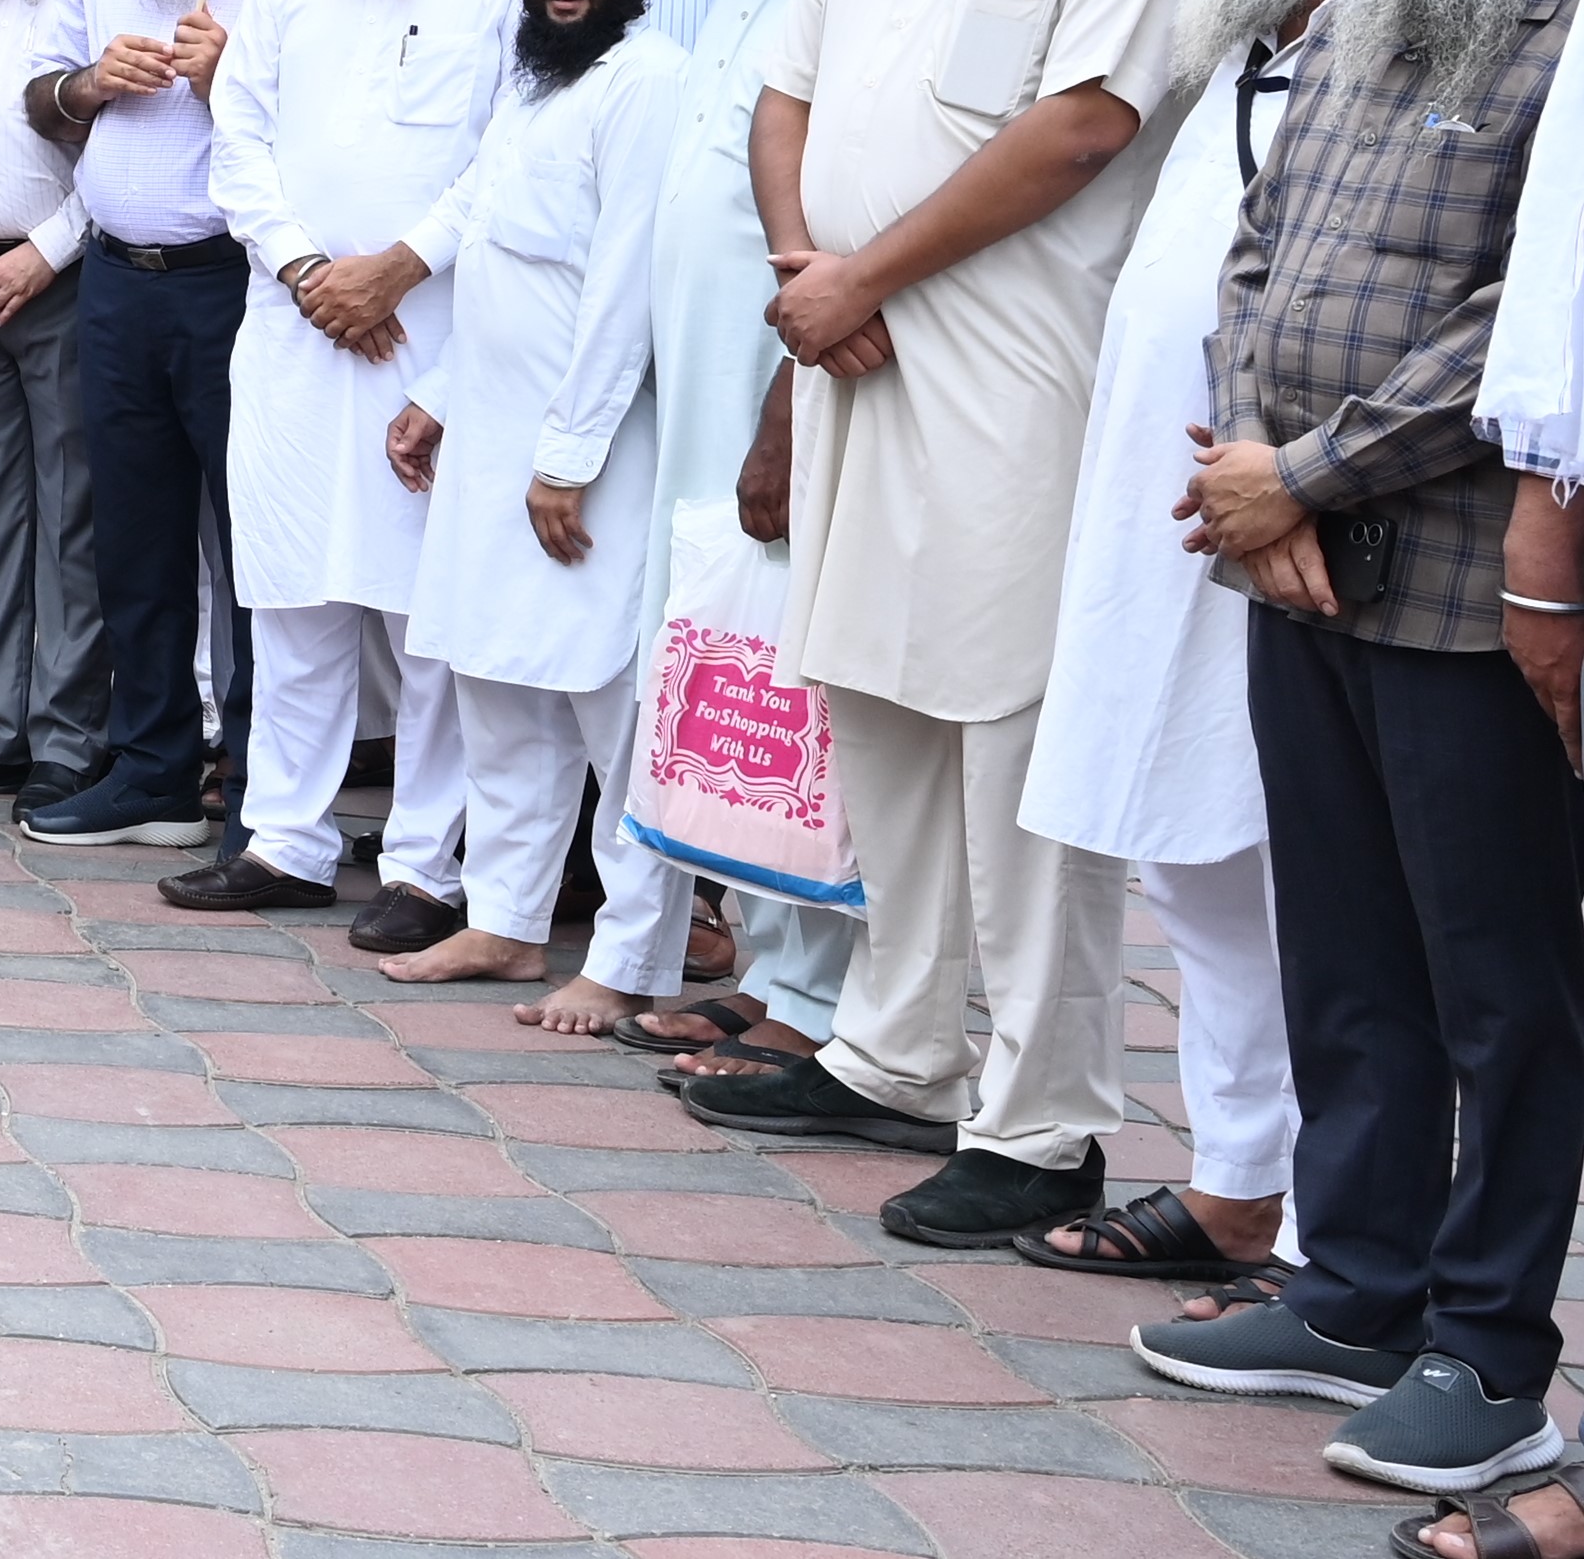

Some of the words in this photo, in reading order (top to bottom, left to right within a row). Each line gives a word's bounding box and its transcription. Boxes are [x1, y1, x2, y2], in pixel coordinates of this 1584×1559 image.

[760, 688, 791, 712] You
[719, 708, 794, 747] Shopping
[748, 745, 773, 767] Us
